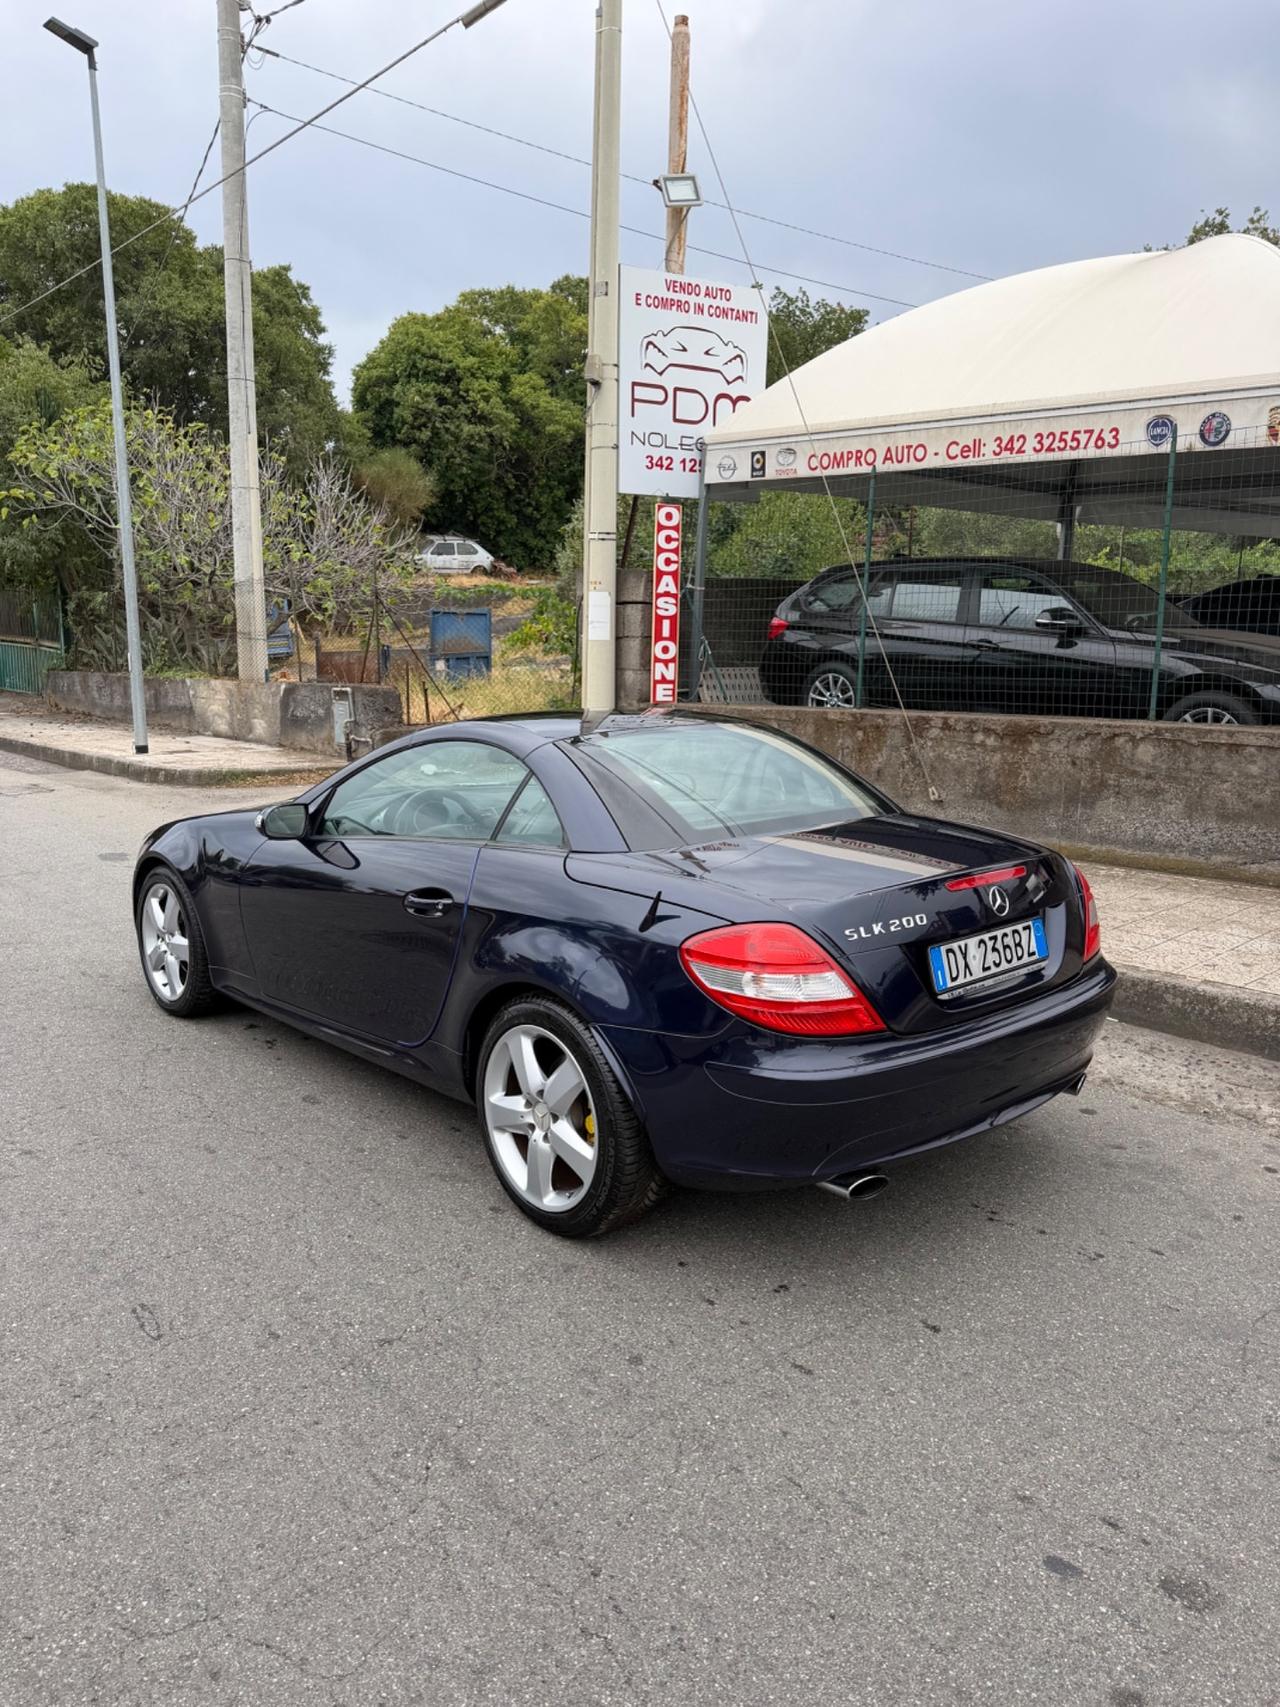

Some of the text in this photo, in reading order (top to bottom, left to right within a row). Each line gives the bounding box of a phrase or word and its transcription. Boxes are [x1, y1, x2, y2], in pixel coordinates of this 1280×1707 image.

[665, 278, 732, 302] VENDO AUTO
[635, 293, 759, 325] E COMPRO IN CONTANTI
[645, 455, 674, 471] 342
[807, 448, 877, 472] COMPRO
[882, 443, 928, 465] AUTO
[945, 438, 987, 462] Cell:
[992, 434, 1026, 457] 342
[1032, 427, 1120, 455] 3255763
[775, 468, 798, 476] TOYOTA
[654, 506, 680, 702] OCCASIONE
[844, 913, 928, 941] SLK 200
[946, 943, 973, 983] DX
[977, 925, 1036, 971] 236BZ
